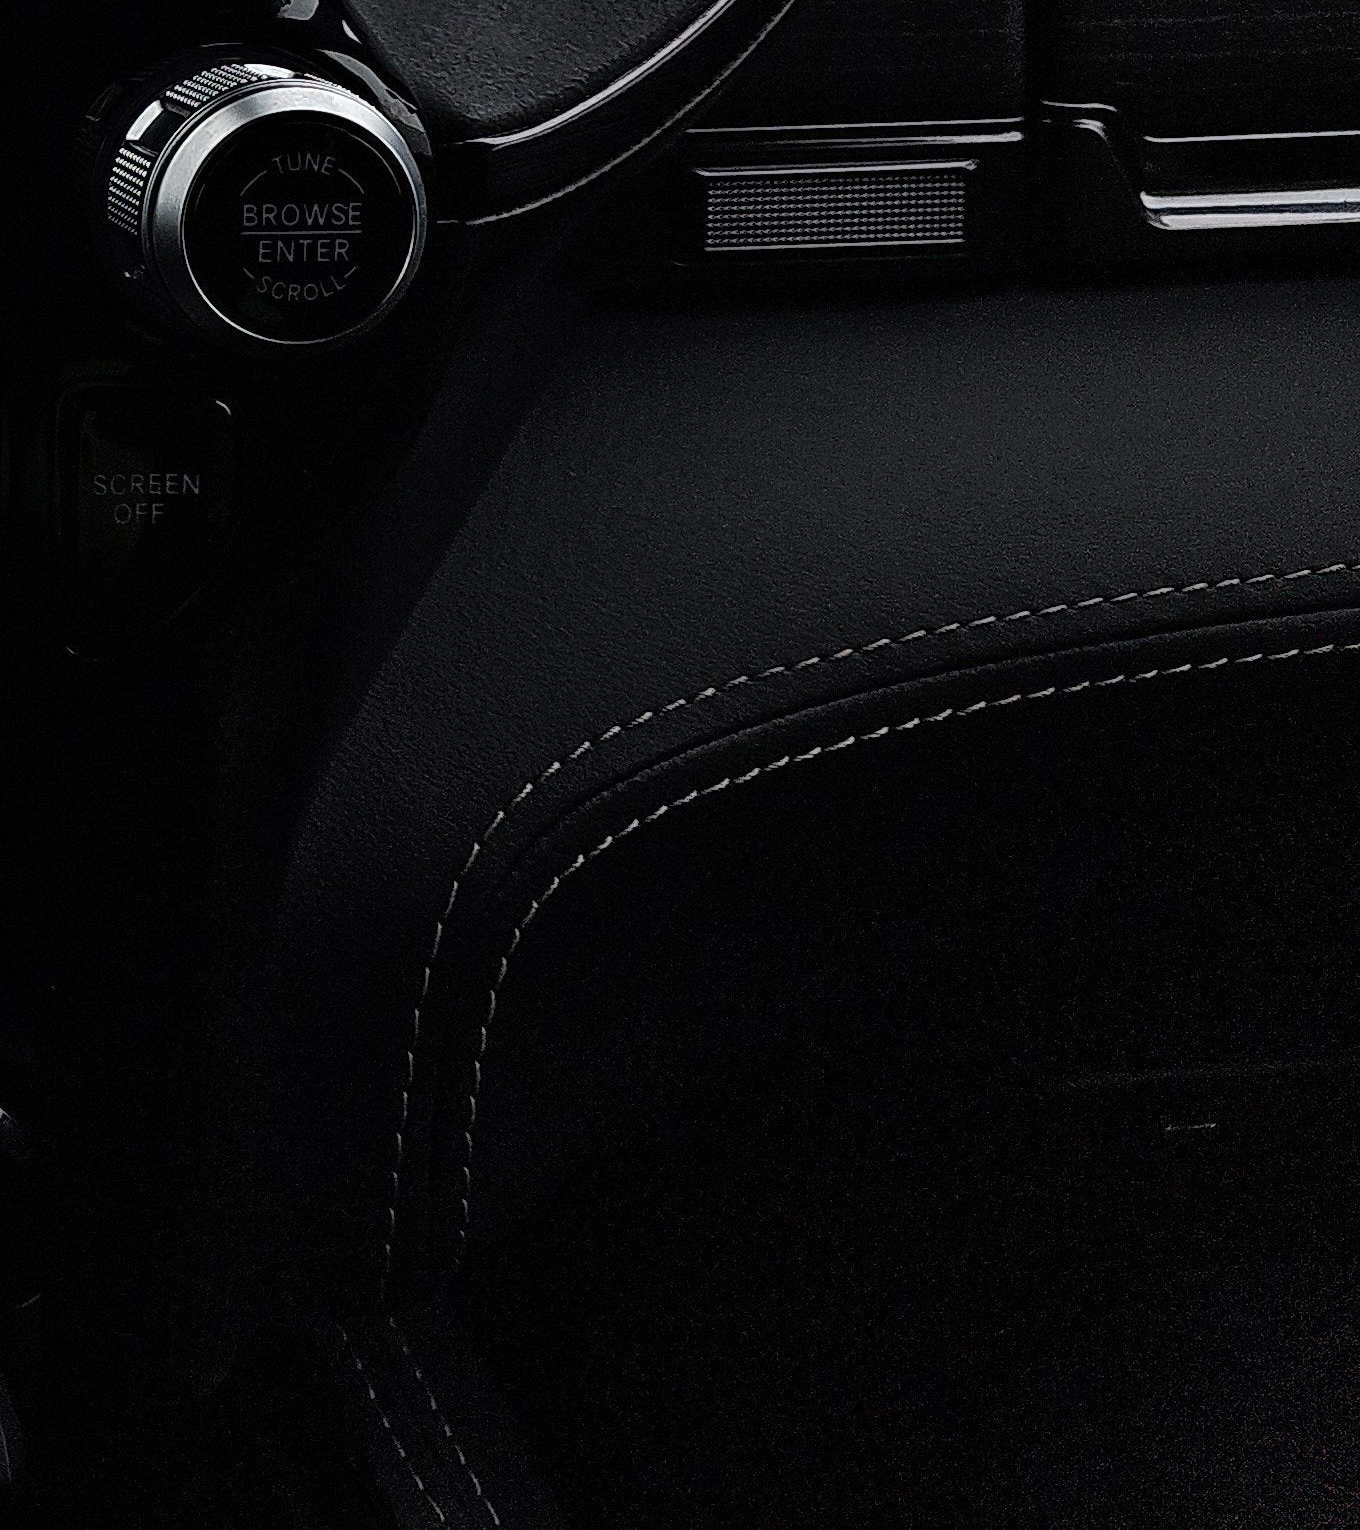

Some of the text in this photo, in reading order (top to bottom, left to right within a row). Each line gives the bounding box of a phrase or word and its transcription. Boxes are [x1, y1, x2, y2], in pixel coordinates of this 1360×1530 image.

[270, 151, 340, 178] TUNE
[241, 200, 364, 227] BROWSE
[257, 237, 352, 263] ENTER
[254, 273, 348, 302] SCROLL
[92, 472, 201, 498] SCREEN
[112, 501, 166, 527] OFF
